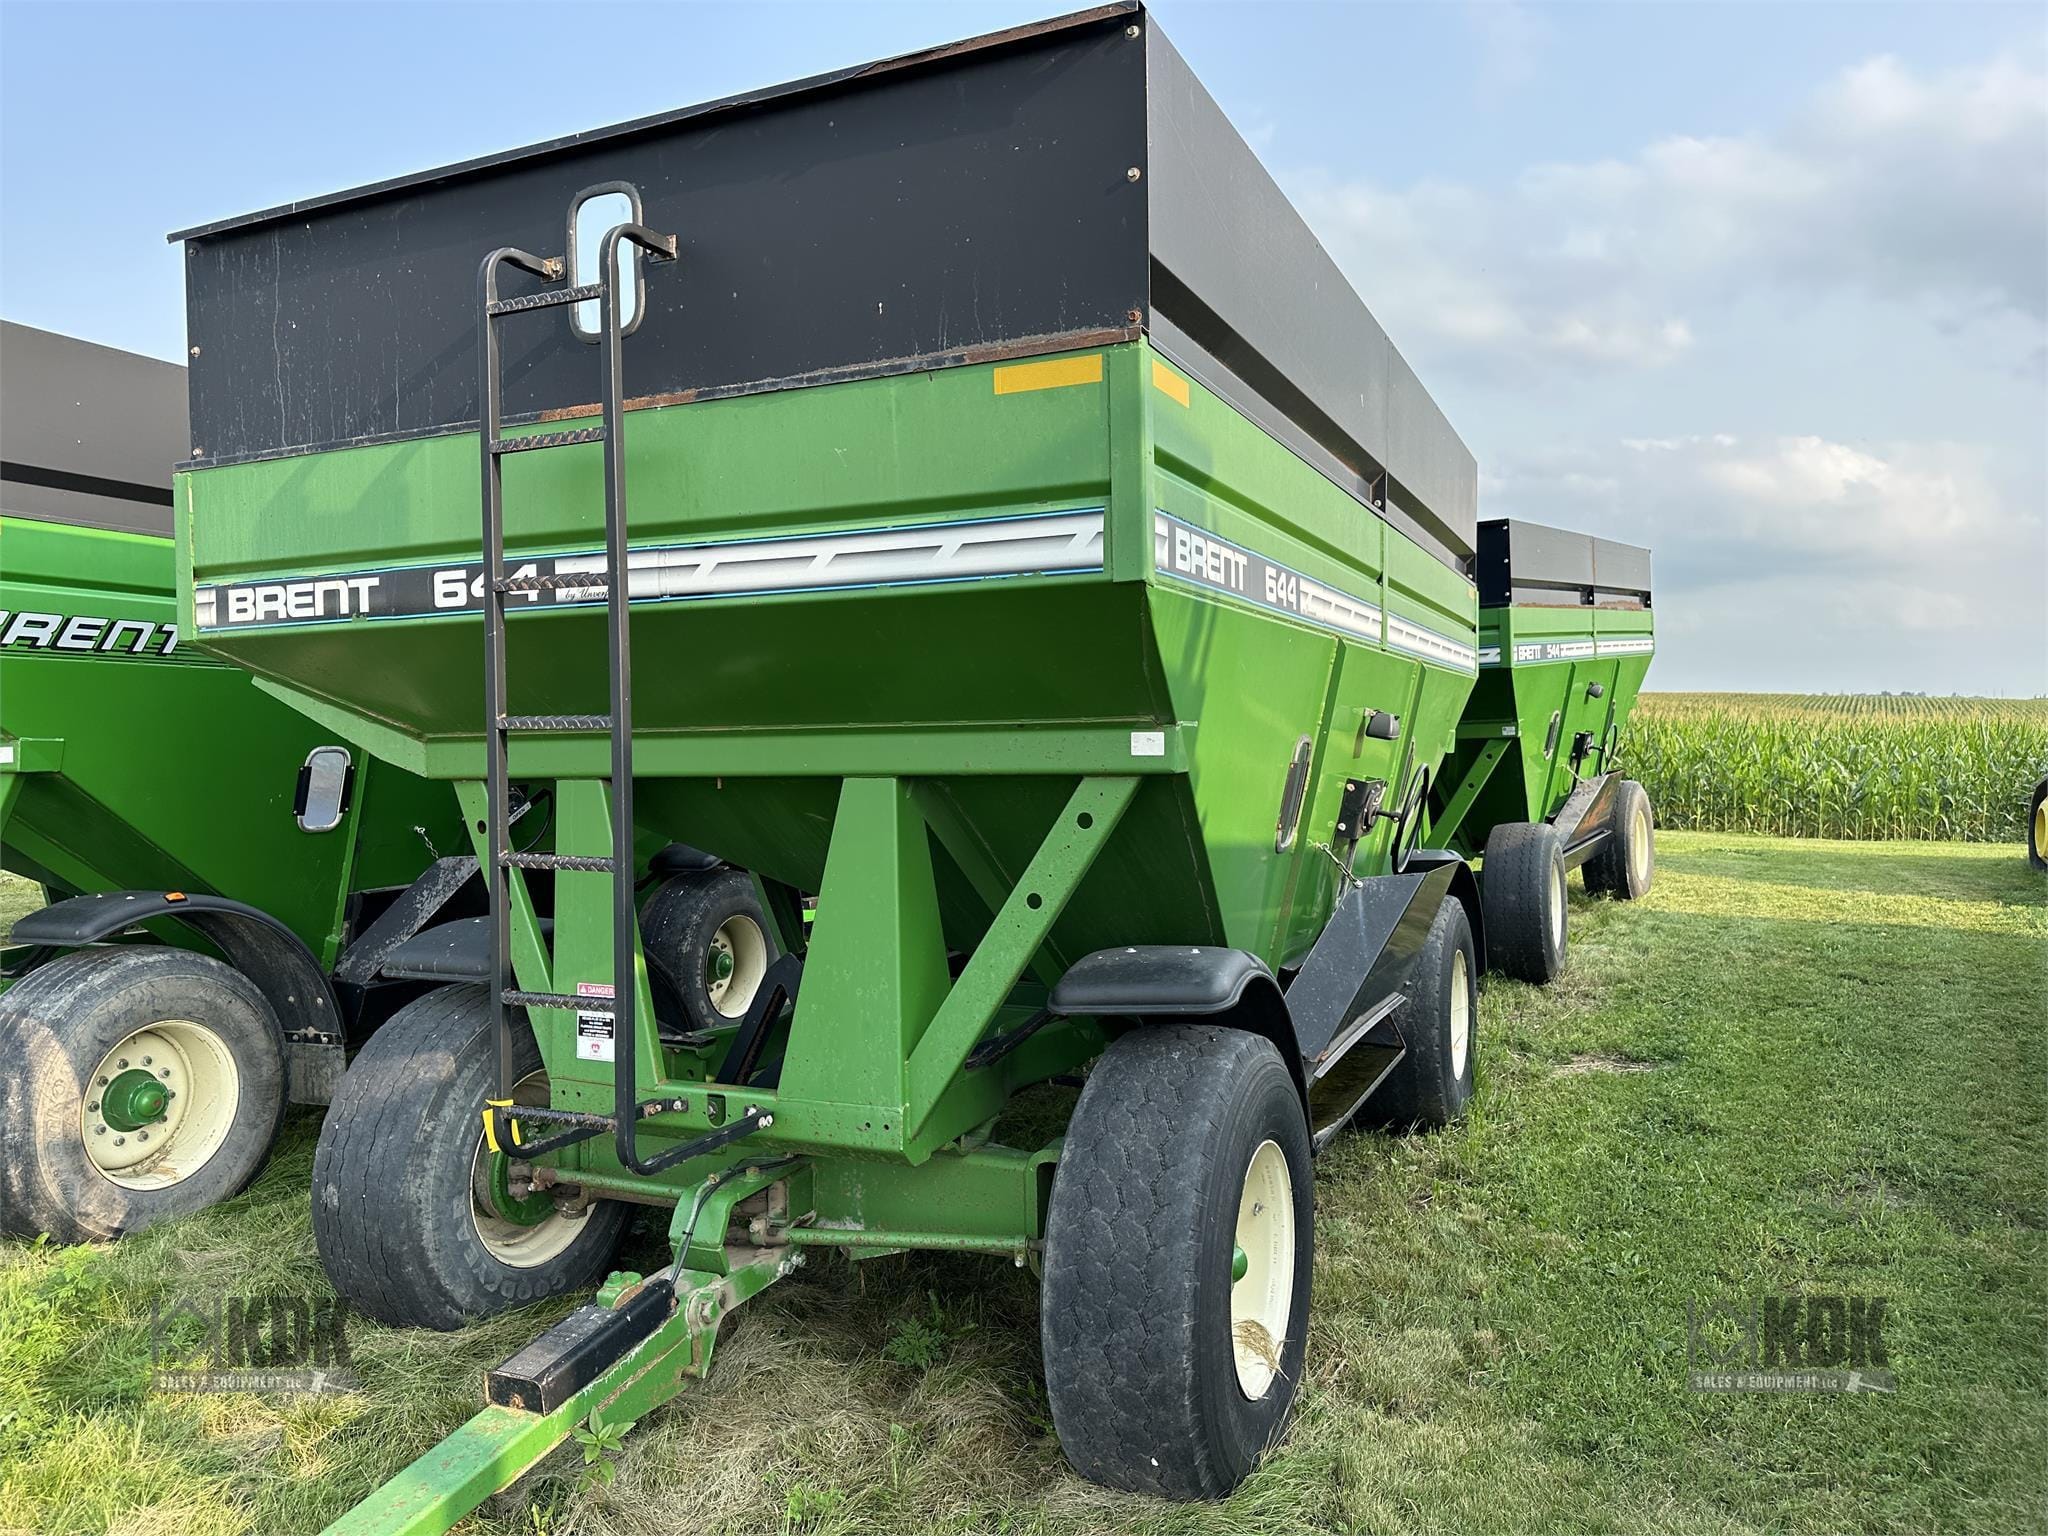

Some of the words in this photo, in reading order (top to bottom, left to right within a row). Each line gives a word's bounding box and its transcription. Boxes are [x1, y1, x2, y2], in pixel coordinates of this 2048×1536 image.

[1175, 526, 1248, 592] BRENT
[1265, 564, 1297, 611] 644
[228, 577, 380, 622] BRENT
[0, 610, 178, 655] RENT
[1519, 644, 1542, 660] BRENT
[1546, 643, 1561, 659] 544
[587, 986, 615, 995] DANGER
